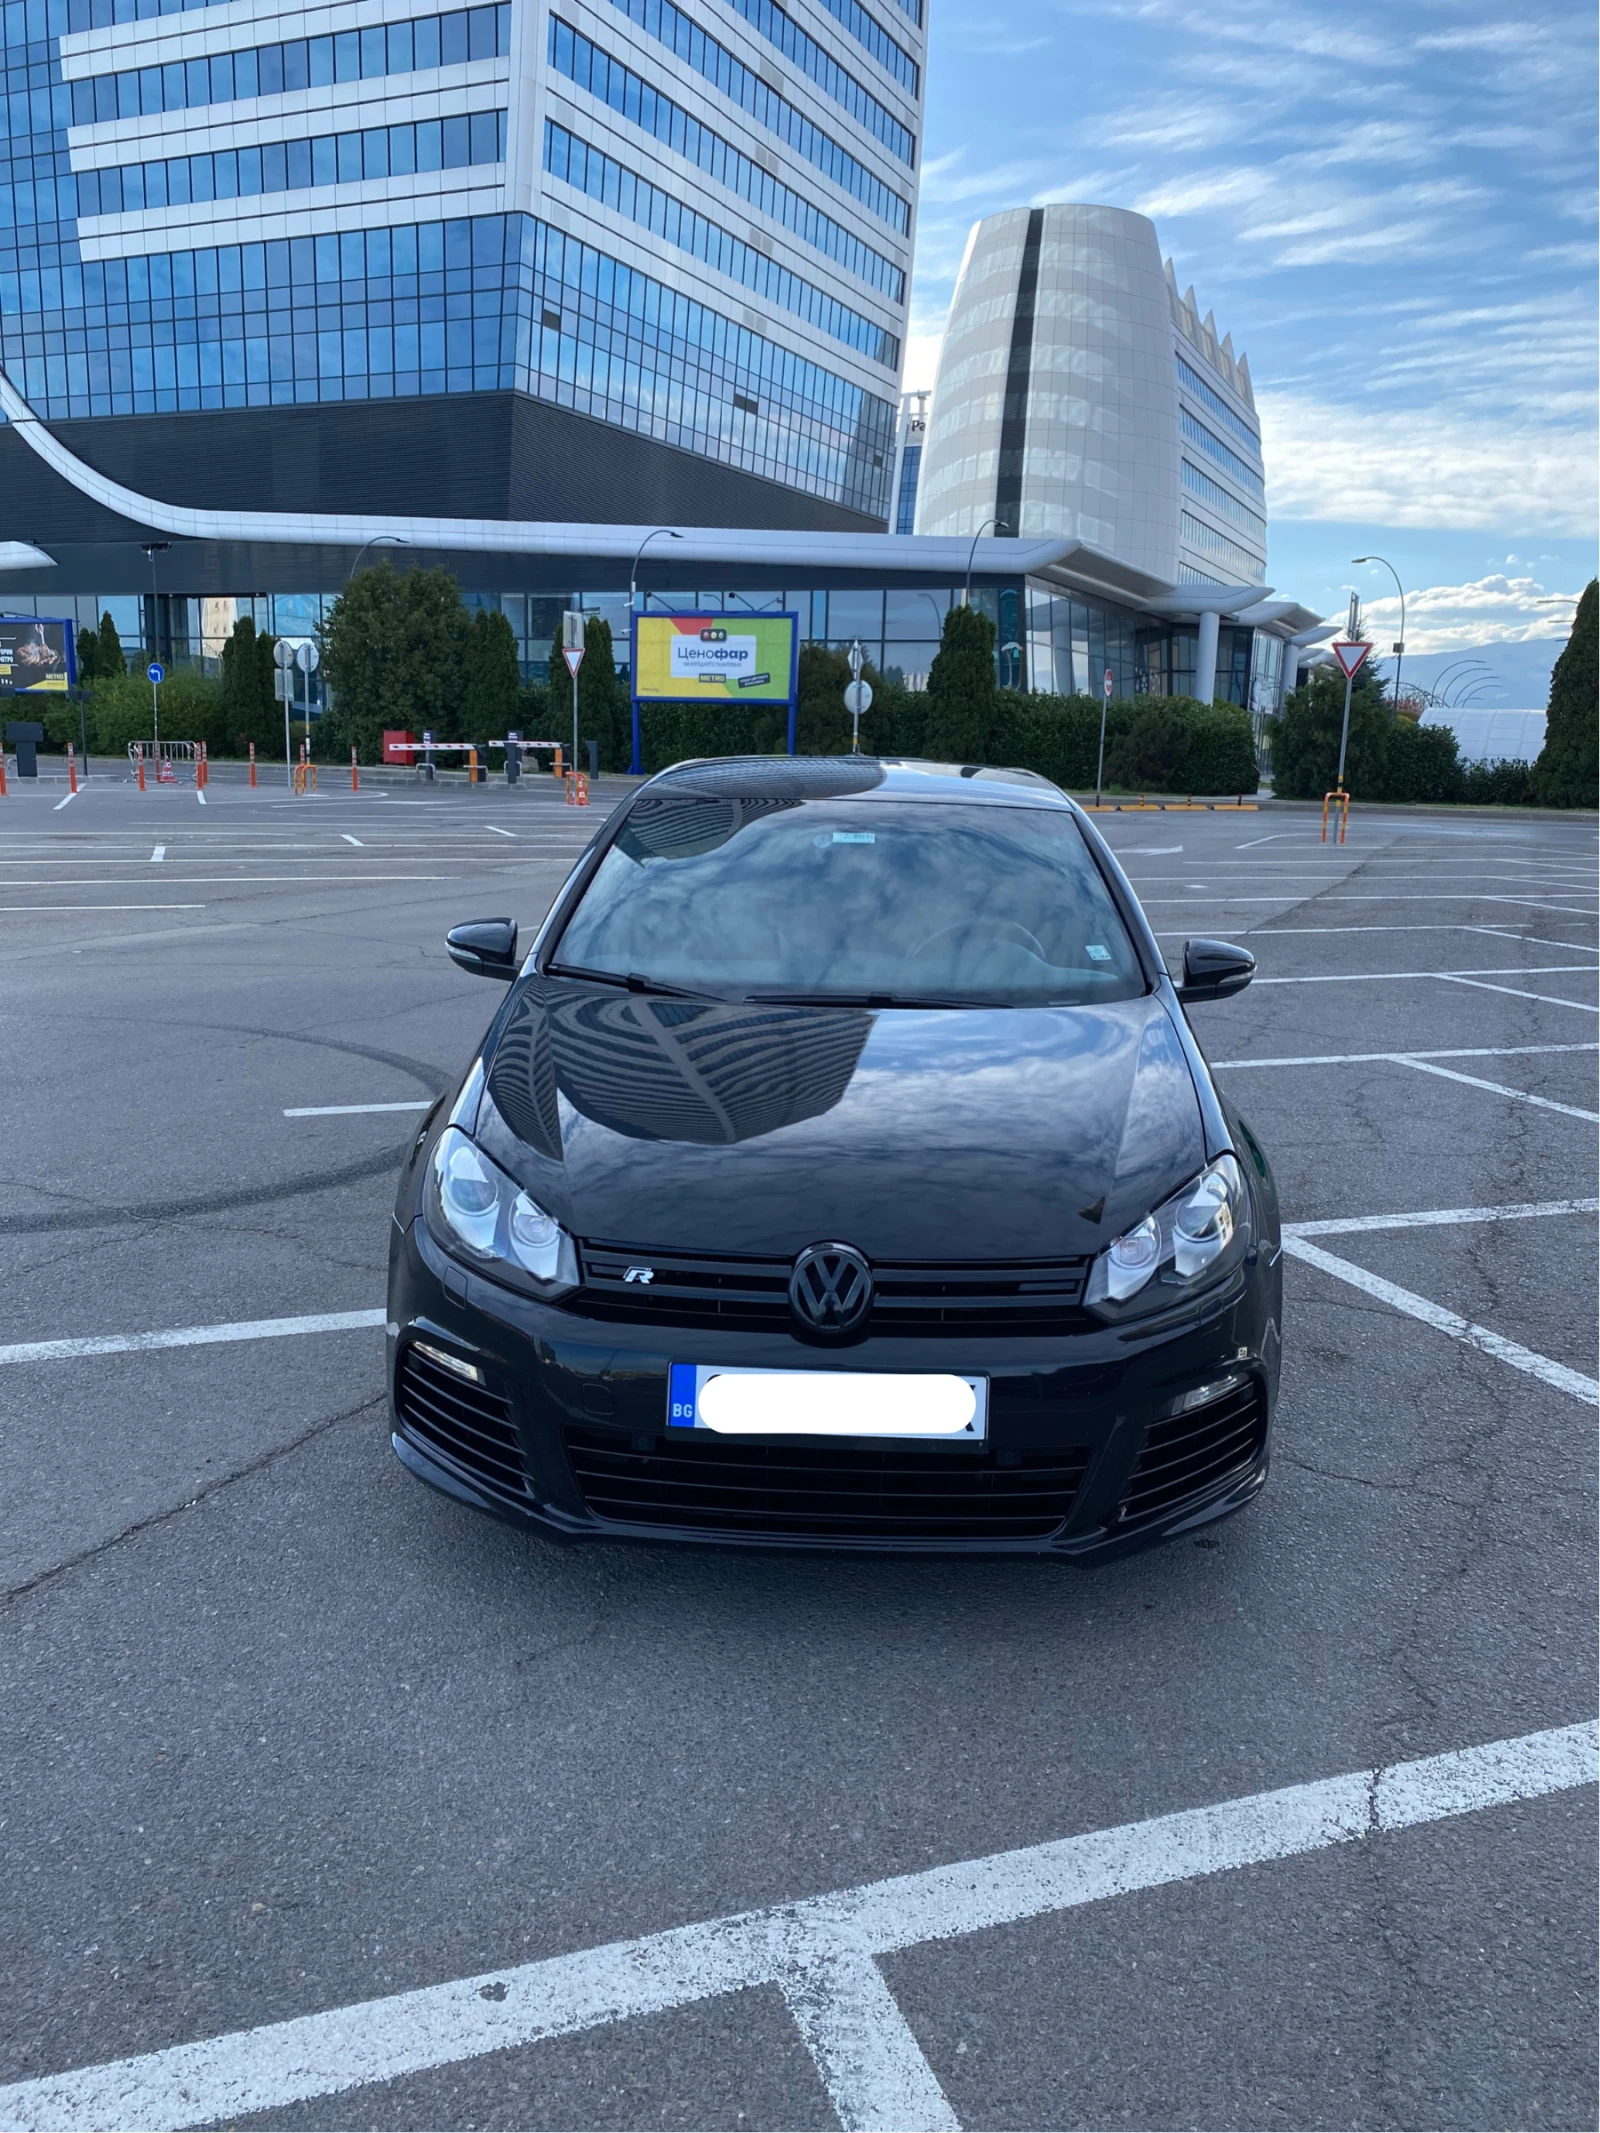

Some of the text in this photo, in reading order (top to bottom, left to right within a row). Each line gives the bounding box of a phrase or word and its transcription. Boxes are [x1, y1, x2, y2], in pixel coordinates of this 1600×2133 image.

[678, 647, 749, 661] Ценофар
[623, 1266, 654, 1284] R
[796, 1254, 870, 1330] VW
[672, 1403, 693, 1418] BG
